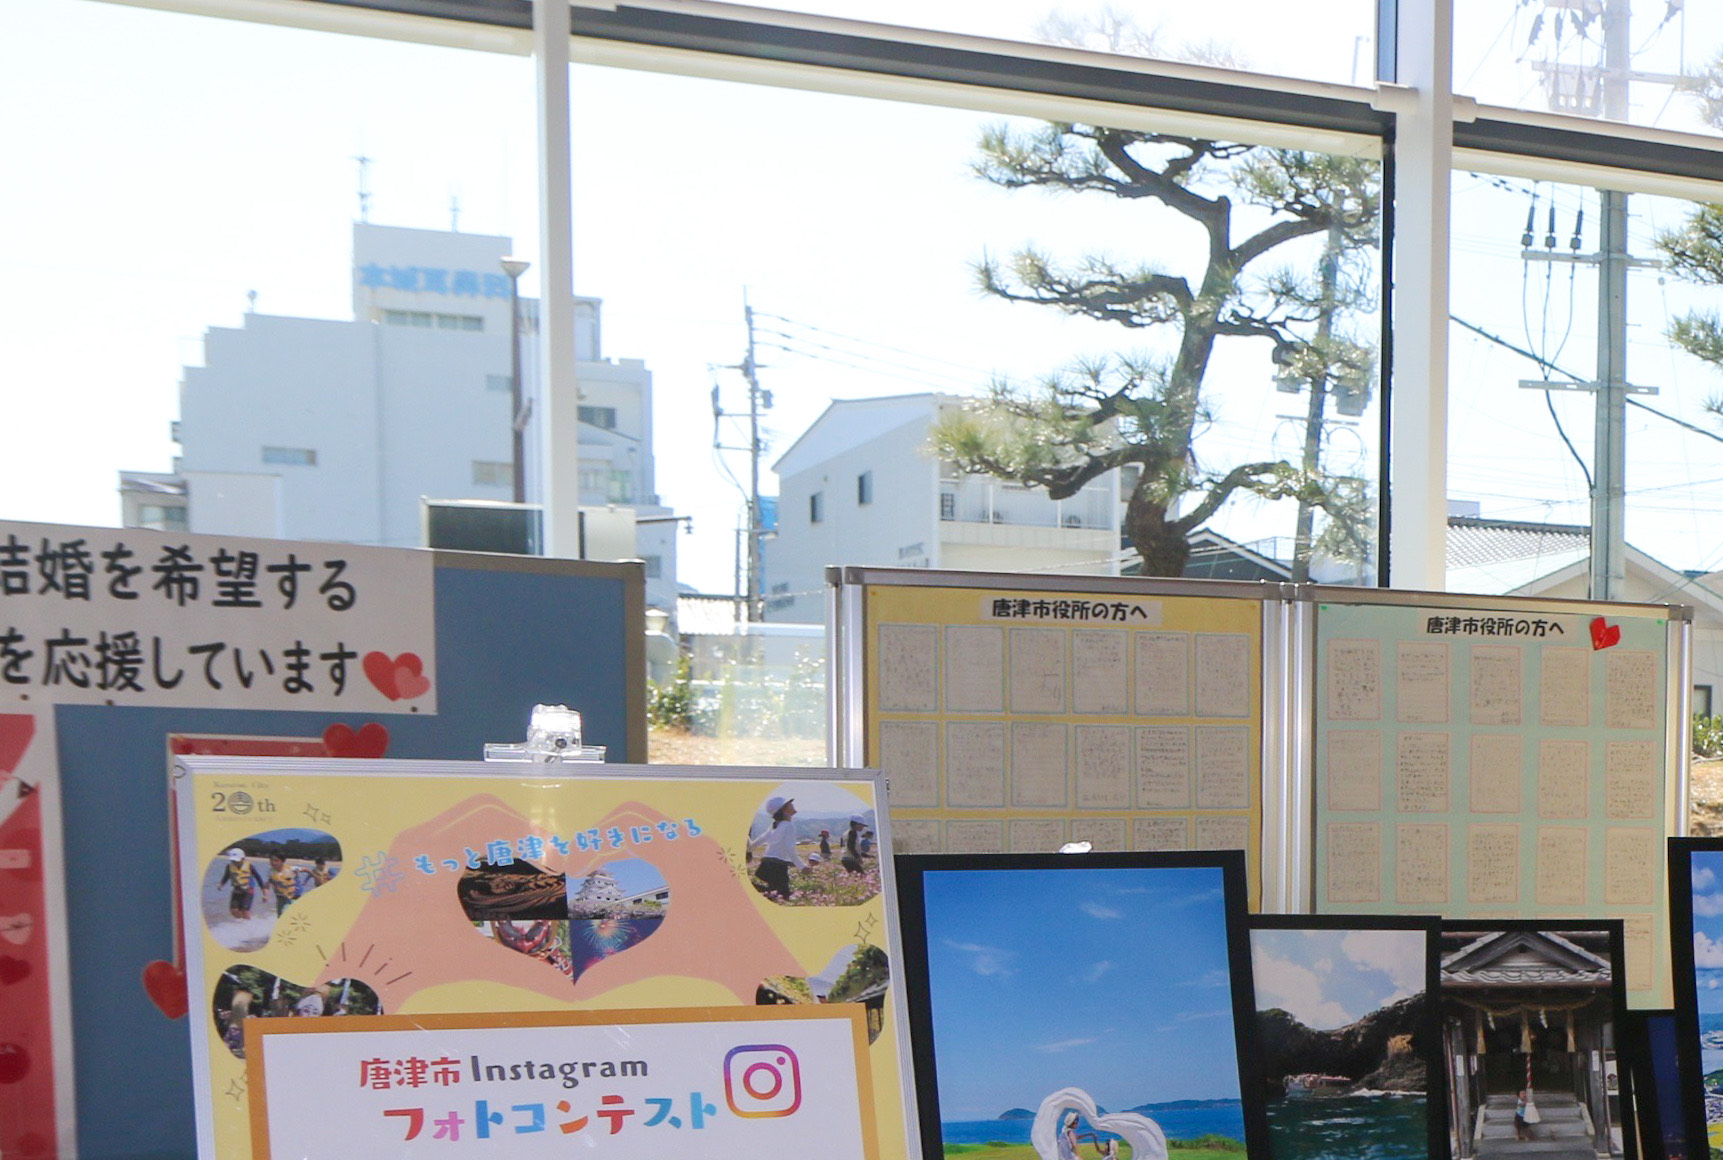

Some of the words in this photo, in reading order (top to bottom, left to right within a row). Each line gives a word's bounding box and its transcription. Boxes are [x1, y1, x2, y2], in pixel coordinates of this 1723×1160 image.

[992, 598, 1148, 622] 唐津市役所の方へ
[1426, 616, 1565, 638] 唐津市役所の方へ
[359, 1056, 461, 1090] 唐津市
[470, 1054, 649, 1090] Instagram
[383, 1091, 717, 1141] フォトコンテスト
